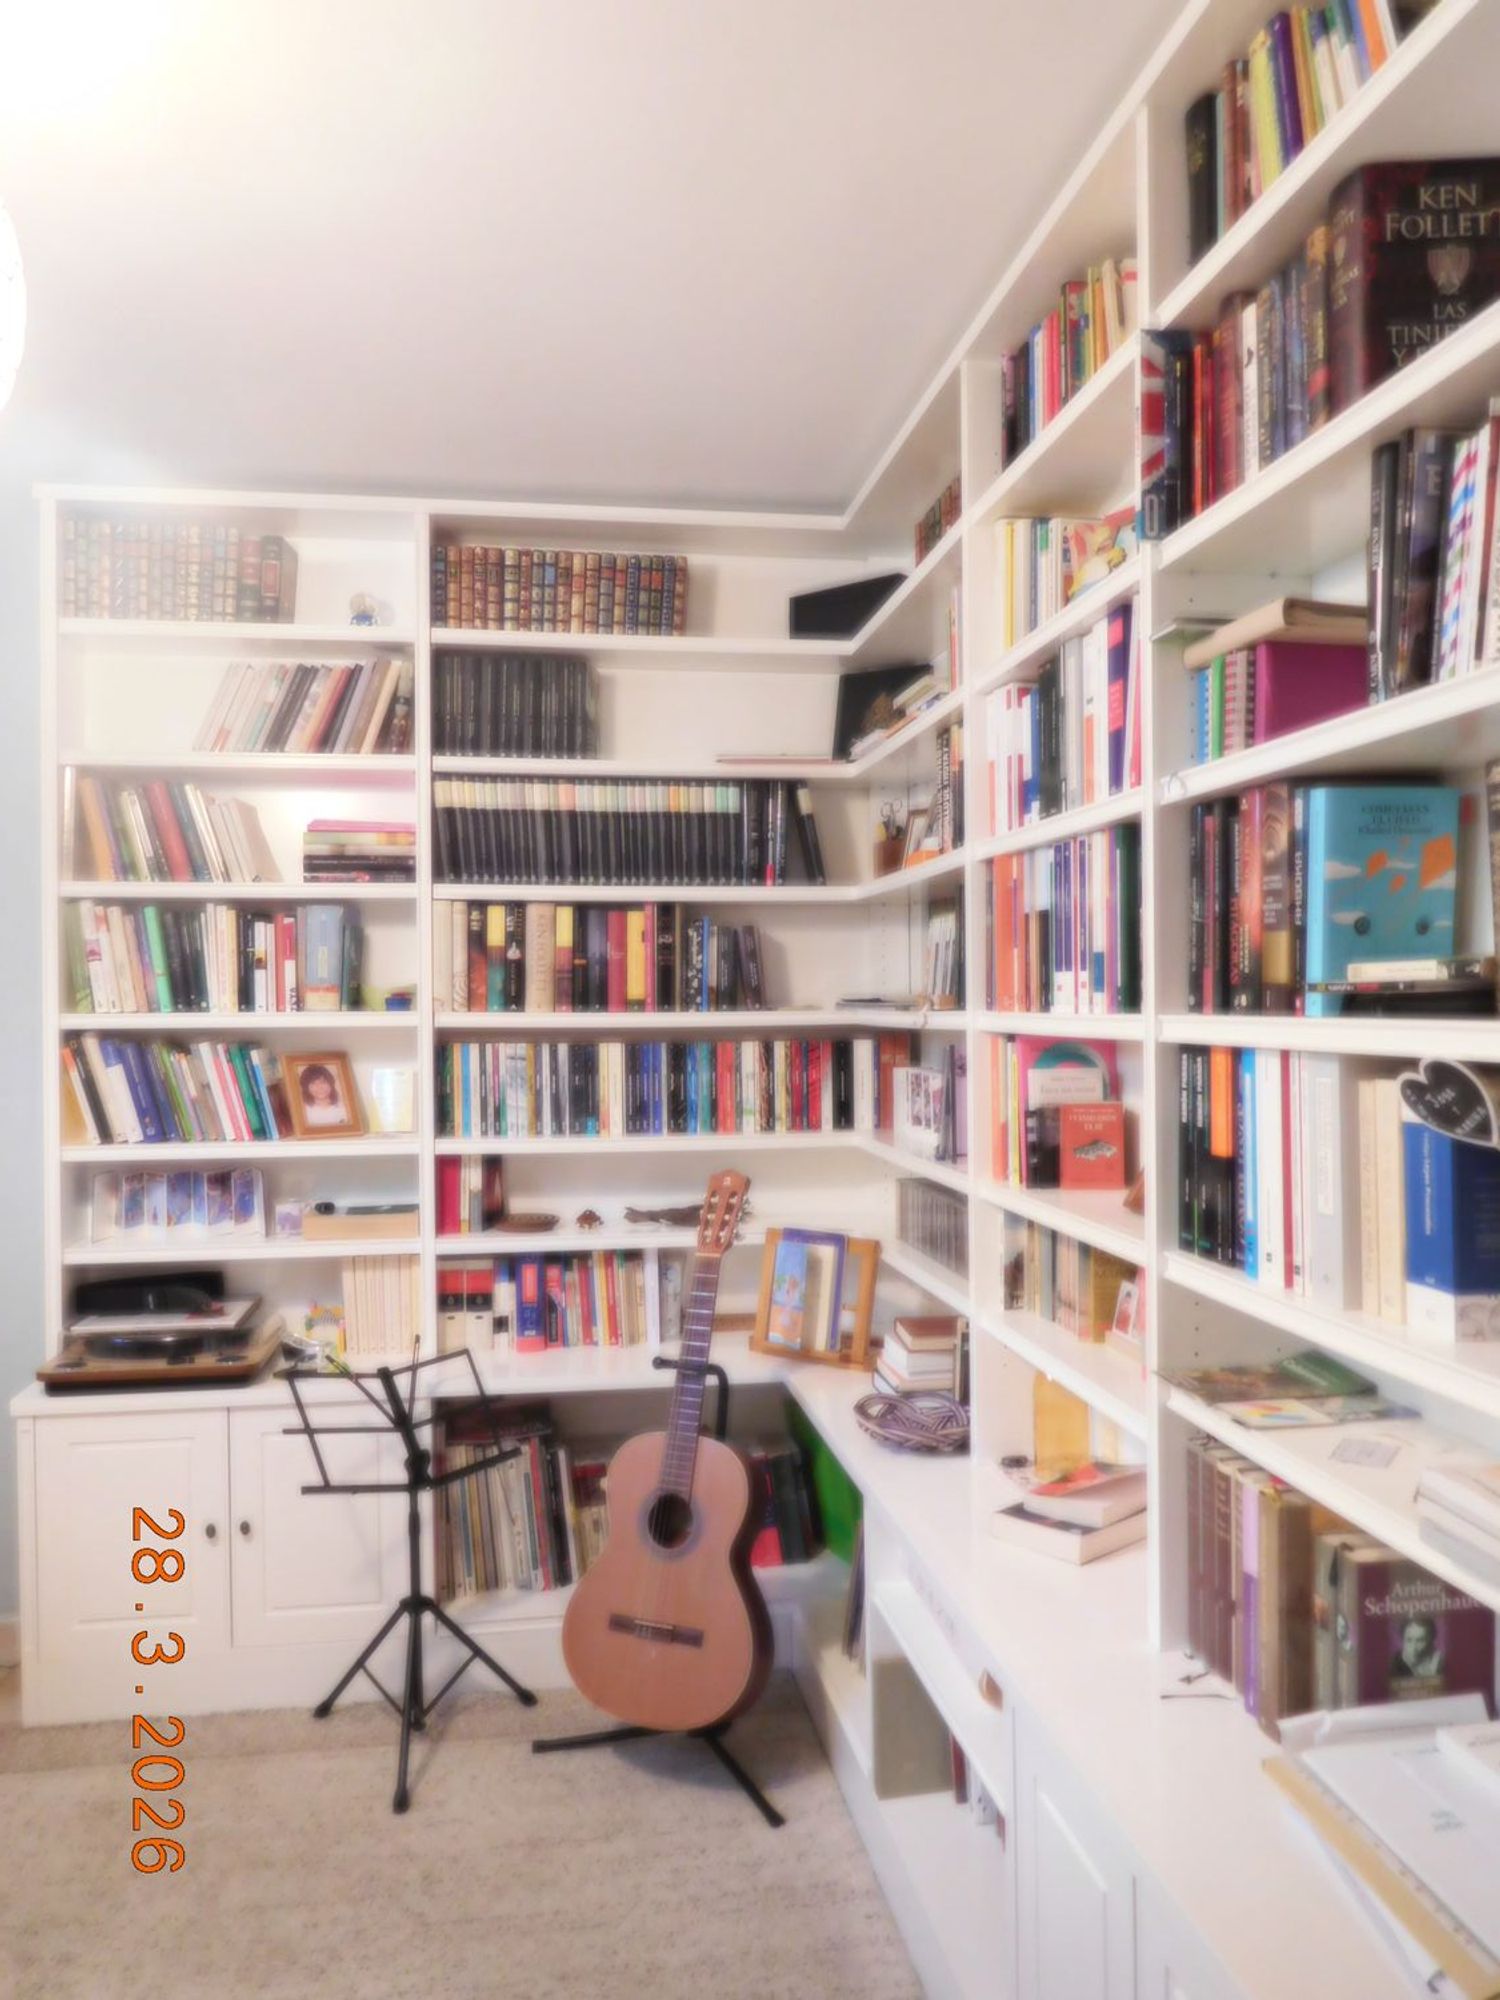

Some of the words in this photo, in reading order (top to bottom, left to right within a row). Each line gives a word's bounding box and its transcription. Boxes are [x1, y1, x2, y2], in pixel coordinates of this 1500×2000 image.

[1419, 183, 1477, 210] KEN
[1433, 303, 1467, 320] LAS
[1386, 322, 1462, 345] TINIE
[1391, 1580, 1444, 1598] Arthur
[1365, 1591, 1480, 1618] Schopenhaue
